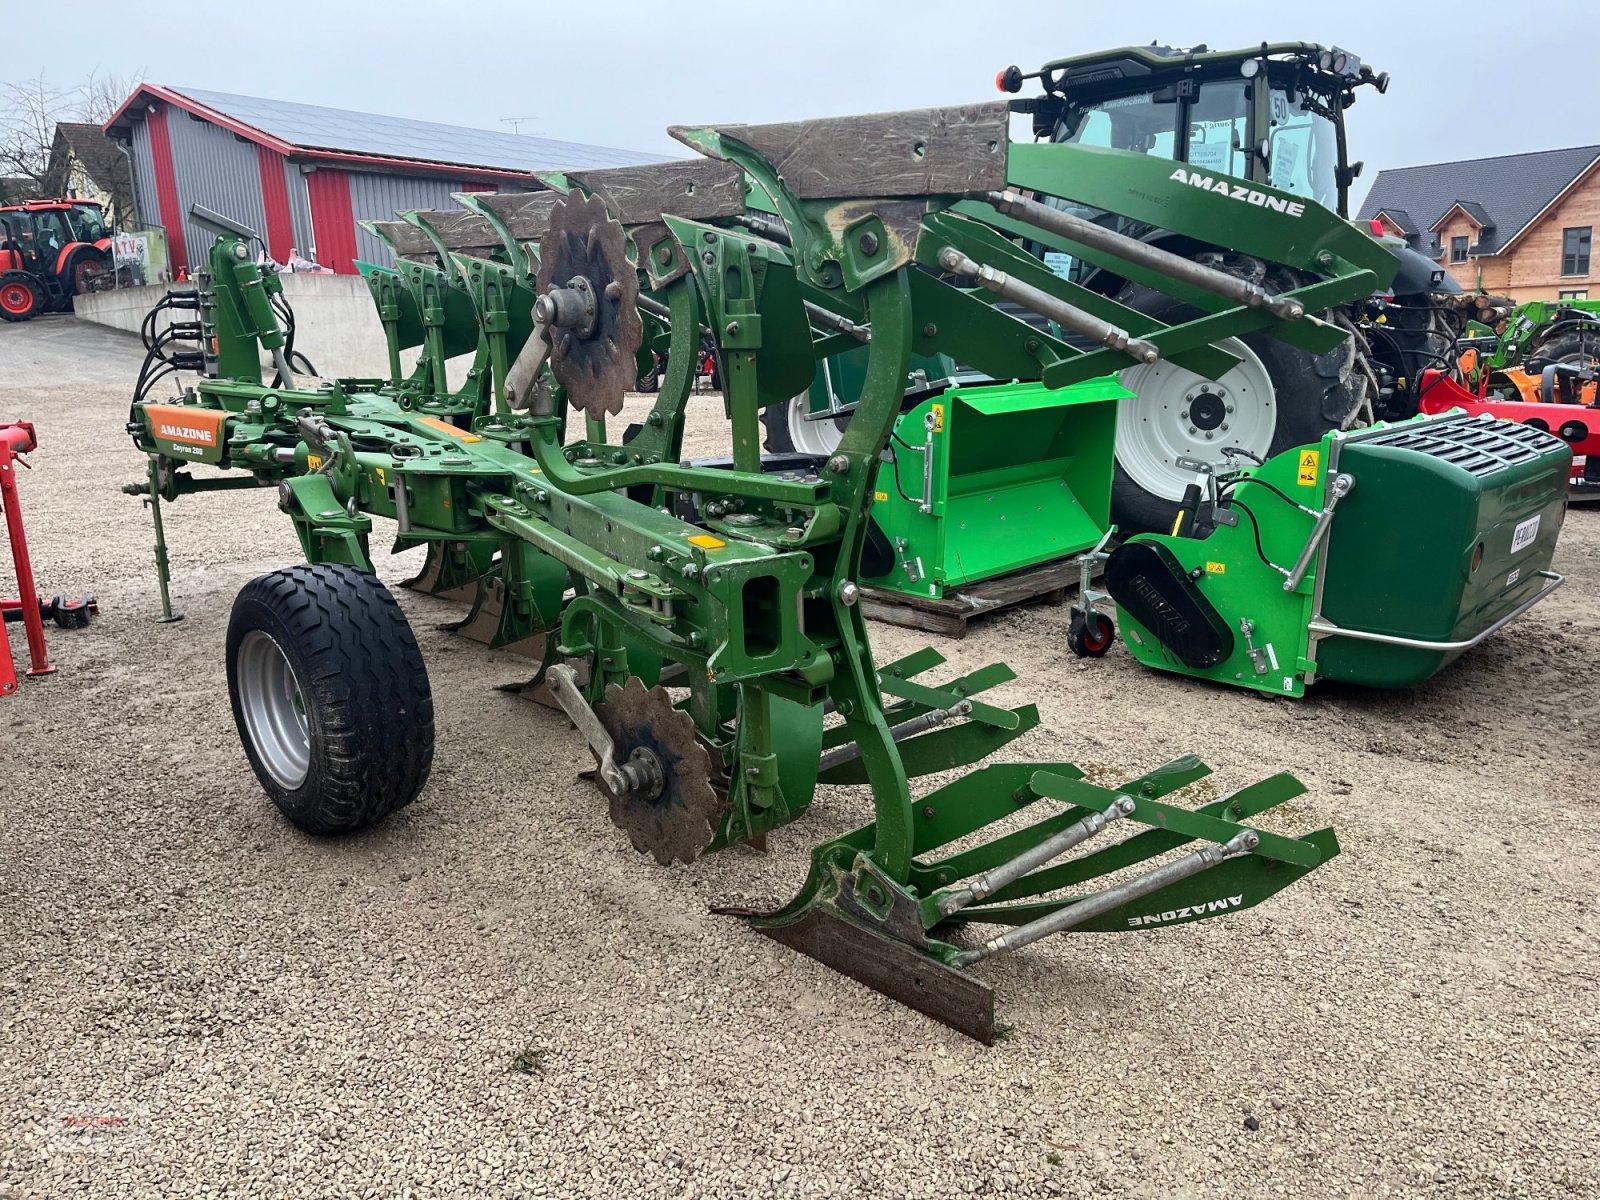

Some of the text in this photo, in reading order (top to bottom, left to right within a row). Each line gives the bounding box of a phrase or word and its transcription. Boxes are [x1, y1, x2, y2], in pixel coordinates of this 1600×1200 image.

[1274, 97, 1287, 120] 50
[1169, 168, 1305, 218] AMAZONE
[160, 424, 212, 442] AMAZONE
[192, 446, 204, 456] 200
[1127, 893, 1243, 927] AMAZONE
